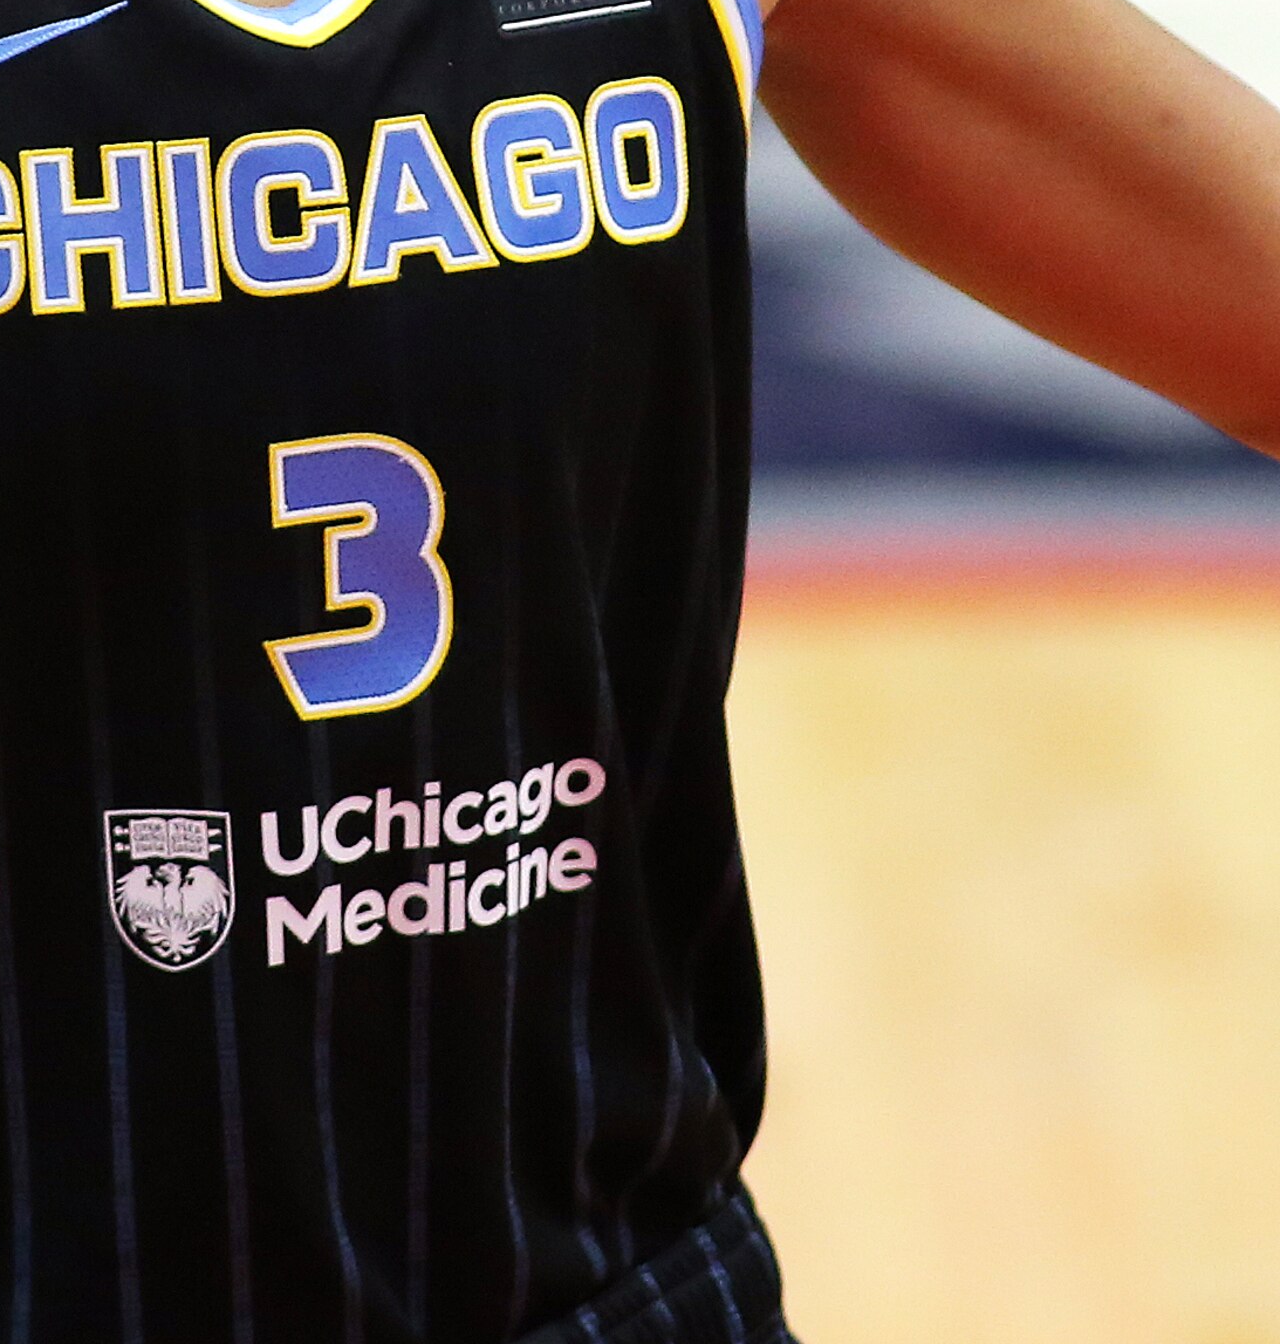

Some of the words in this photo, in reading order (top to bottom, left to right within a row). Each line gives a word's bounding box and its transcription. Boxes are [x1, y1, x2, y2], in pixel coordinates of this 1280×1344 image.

[263, 432, 454, 721] 3
[260, 757, 607, 877] UChicago
[265, 837, 598, 967] Medicine
